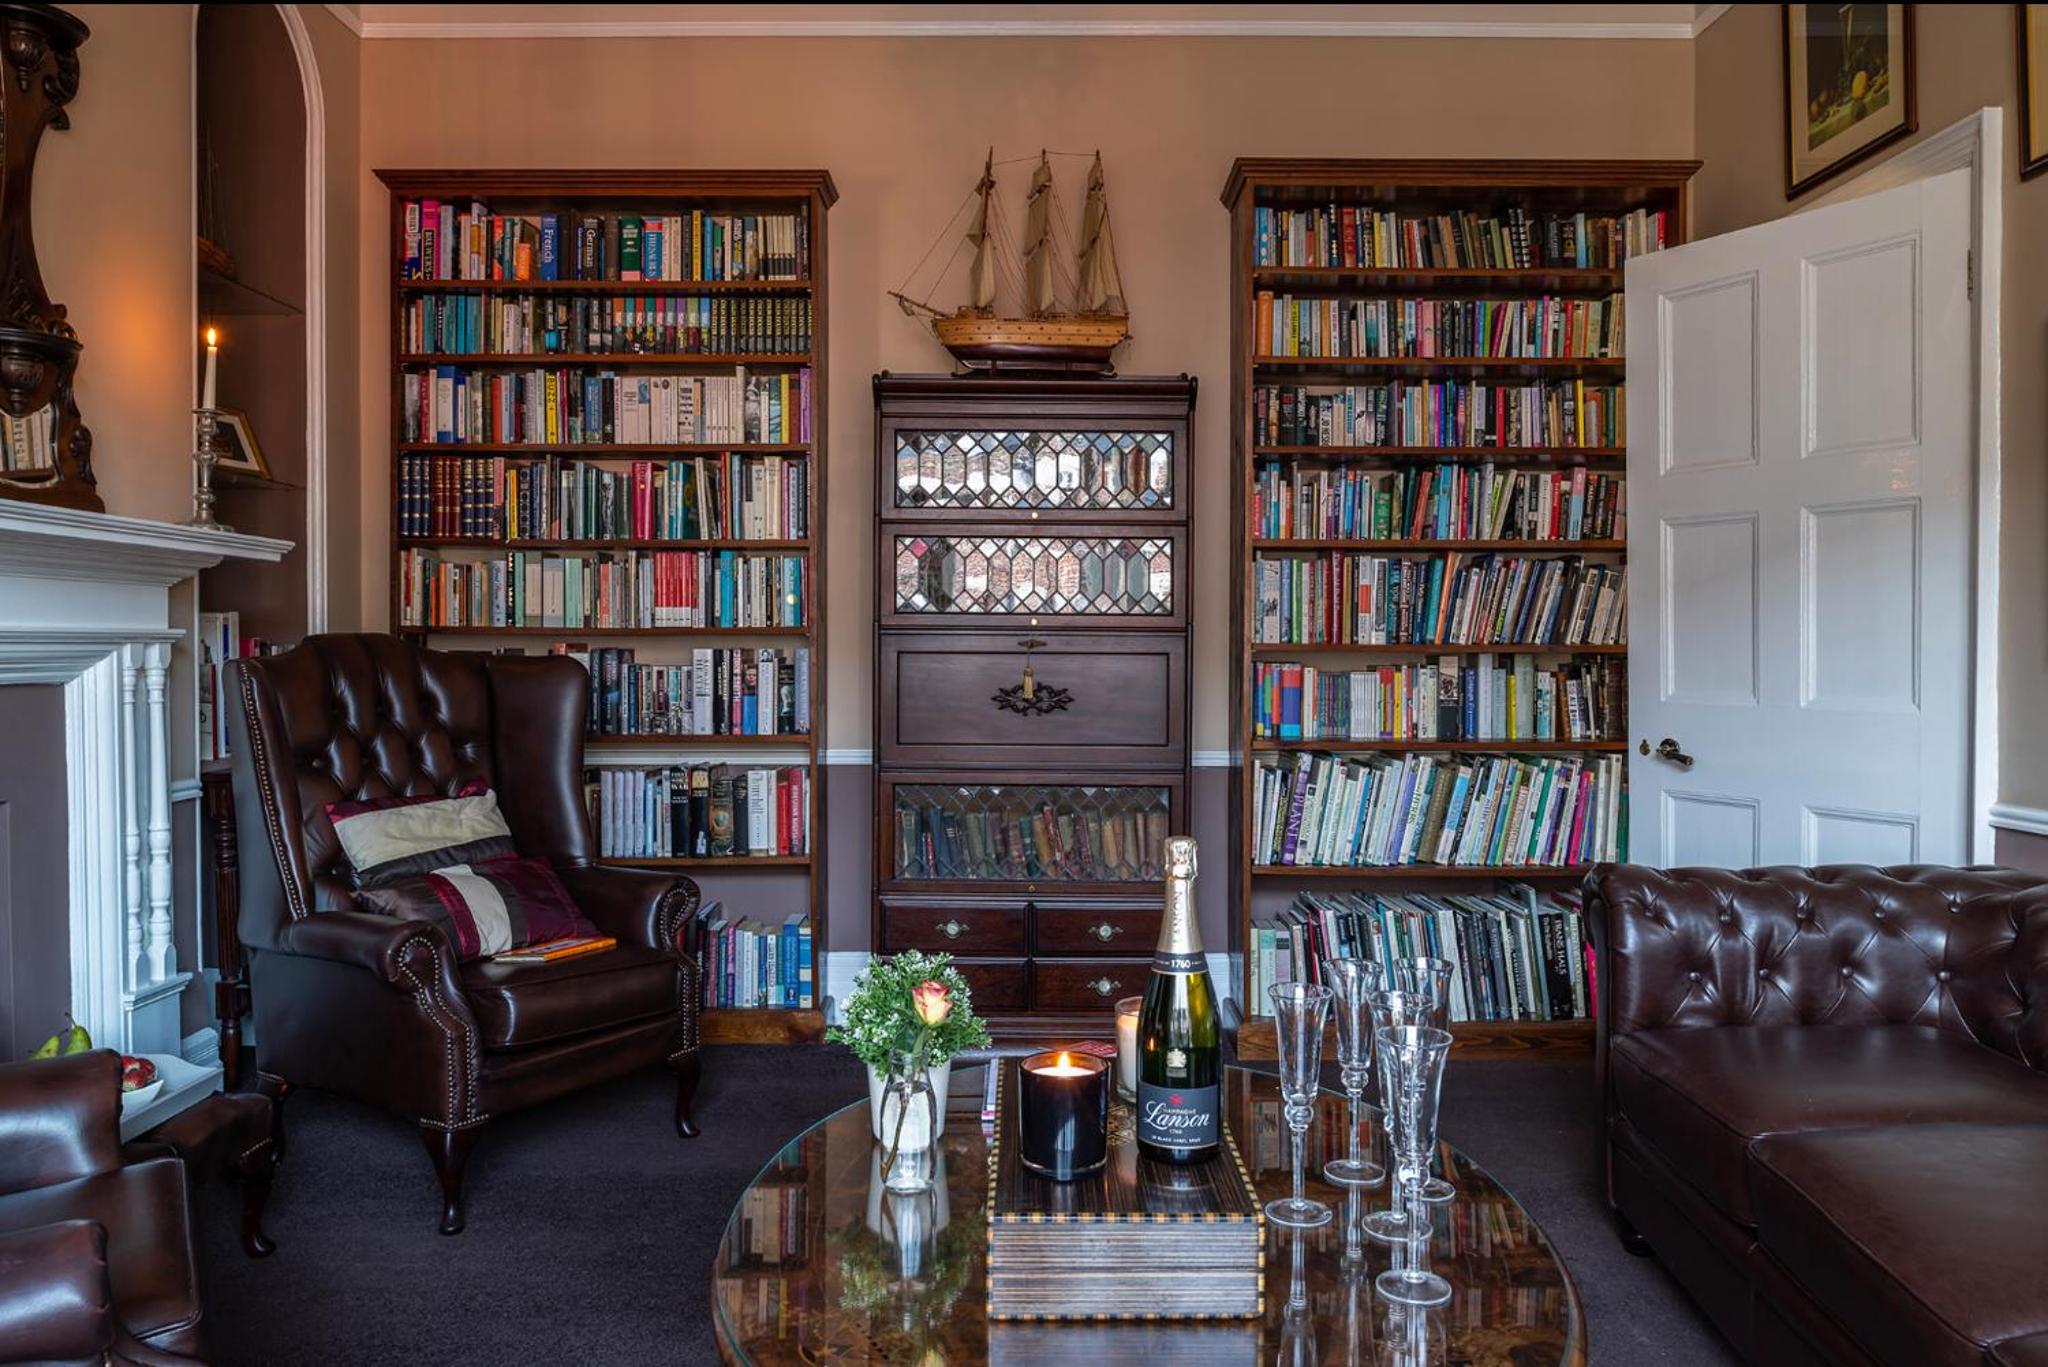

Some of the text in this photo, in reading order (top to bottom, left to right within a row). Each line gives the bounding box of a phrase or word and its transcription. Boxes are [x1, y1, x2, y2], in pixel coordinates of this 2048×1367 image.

[542, 229, 556, 263] French
[584, 229, 597, 268] German
[646, 234, 657, 277] THESAURUS
[548, 378, 557, 403] BUZZ
[694, 659, 703, 692] HEATH
[748, 773, 766, 814] Churchill
[1288, 795, 1304, 841] PLANT
[1170, 959, 1192, 969] 1760
[1554, 918, 1567, 976] FRANS HALS
[1143, 1100, 1210, 1130] Lanson
